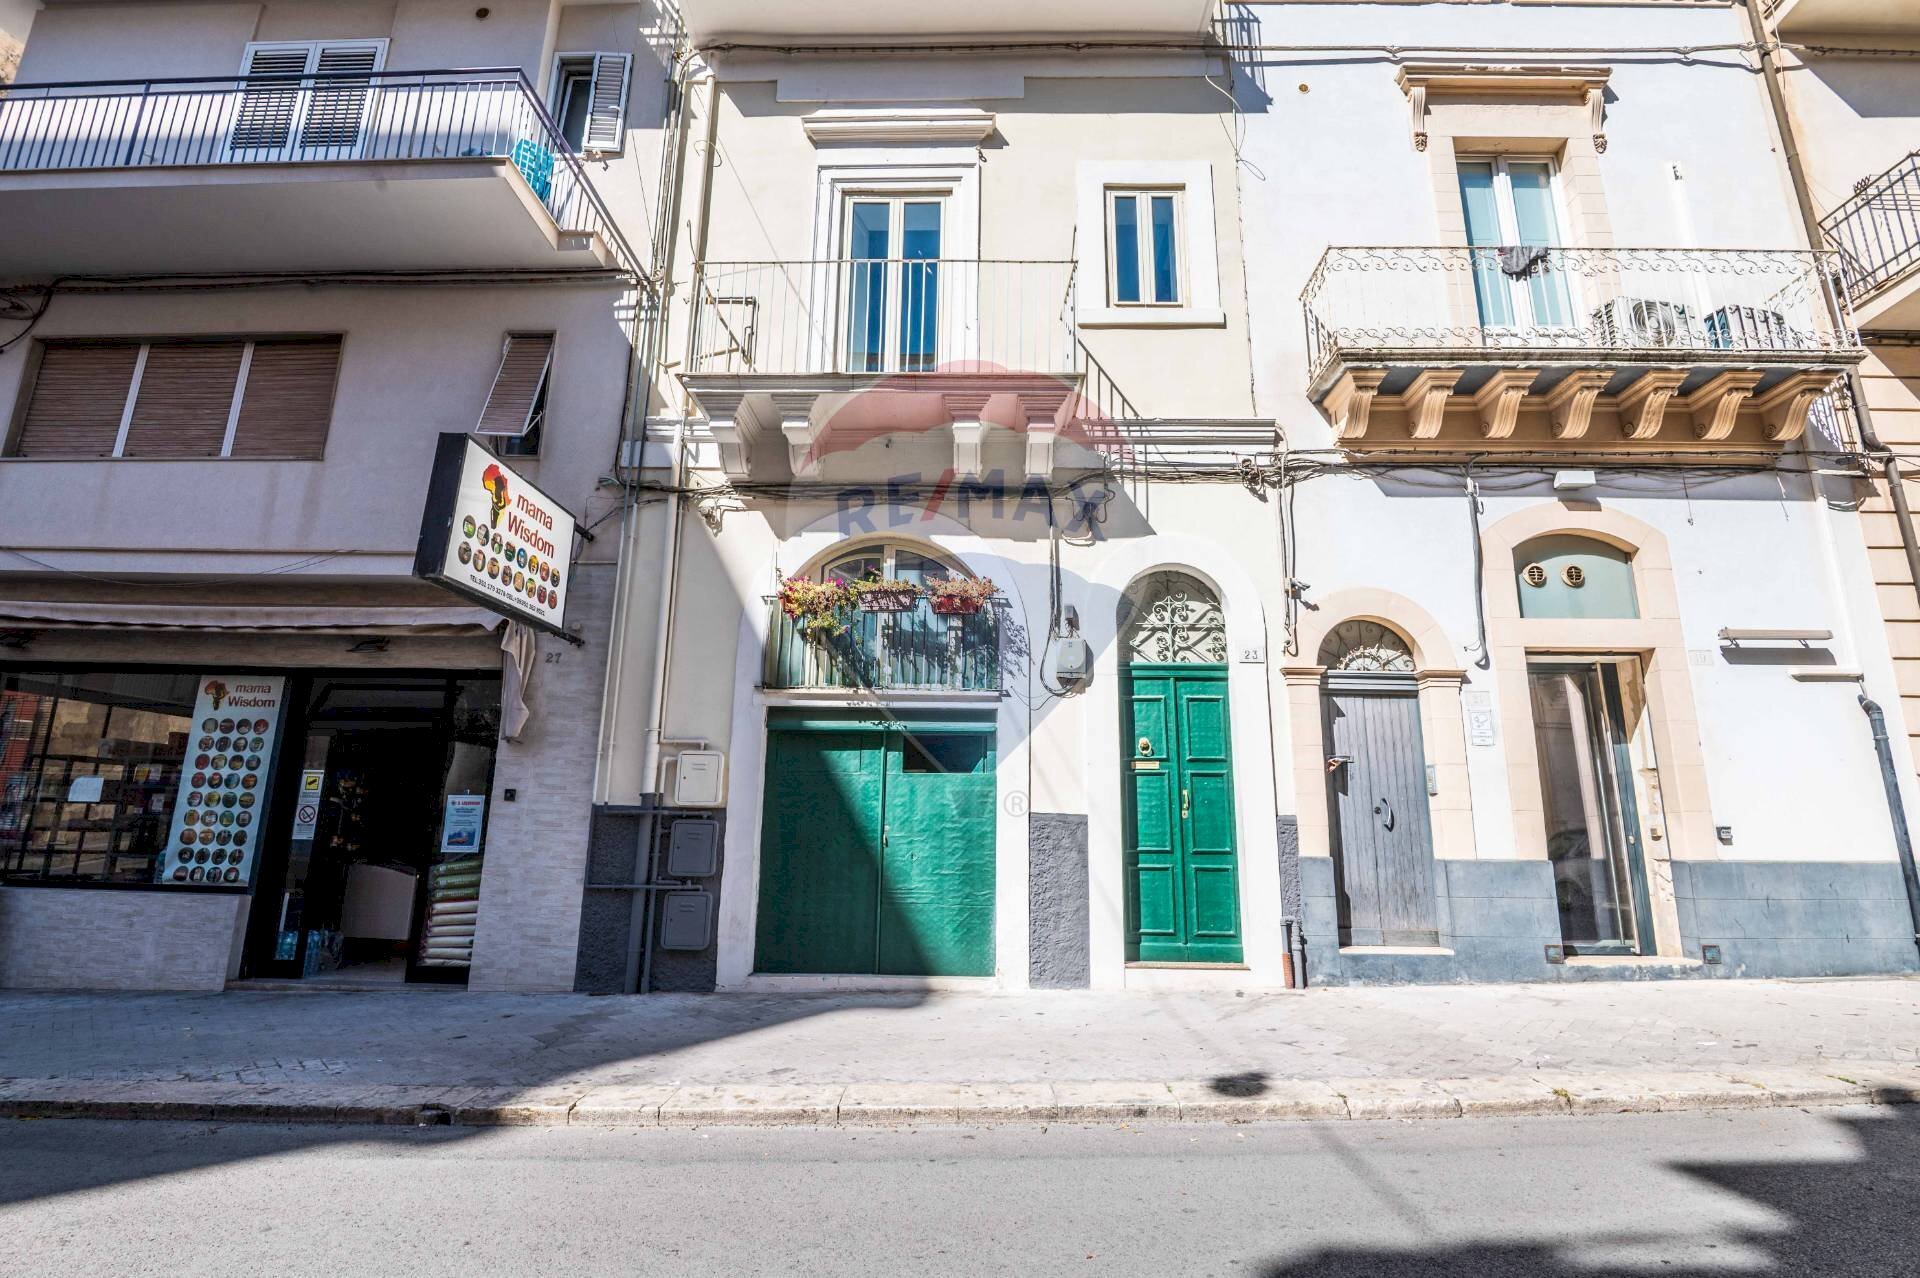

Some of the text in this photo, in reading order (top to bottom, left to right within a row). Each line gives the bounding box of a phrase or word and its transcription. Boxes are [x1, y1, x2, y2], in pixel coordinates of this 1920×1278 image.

[517, 494, 553, 530] mama
[508, 511, 555, 559] Wisdom
[545, 652, 562, 664] 27
[1244, 649, 1258, 660] 23
[235, 684, 272, 694] mama
[228, 696, 276, 708] Wisdom
